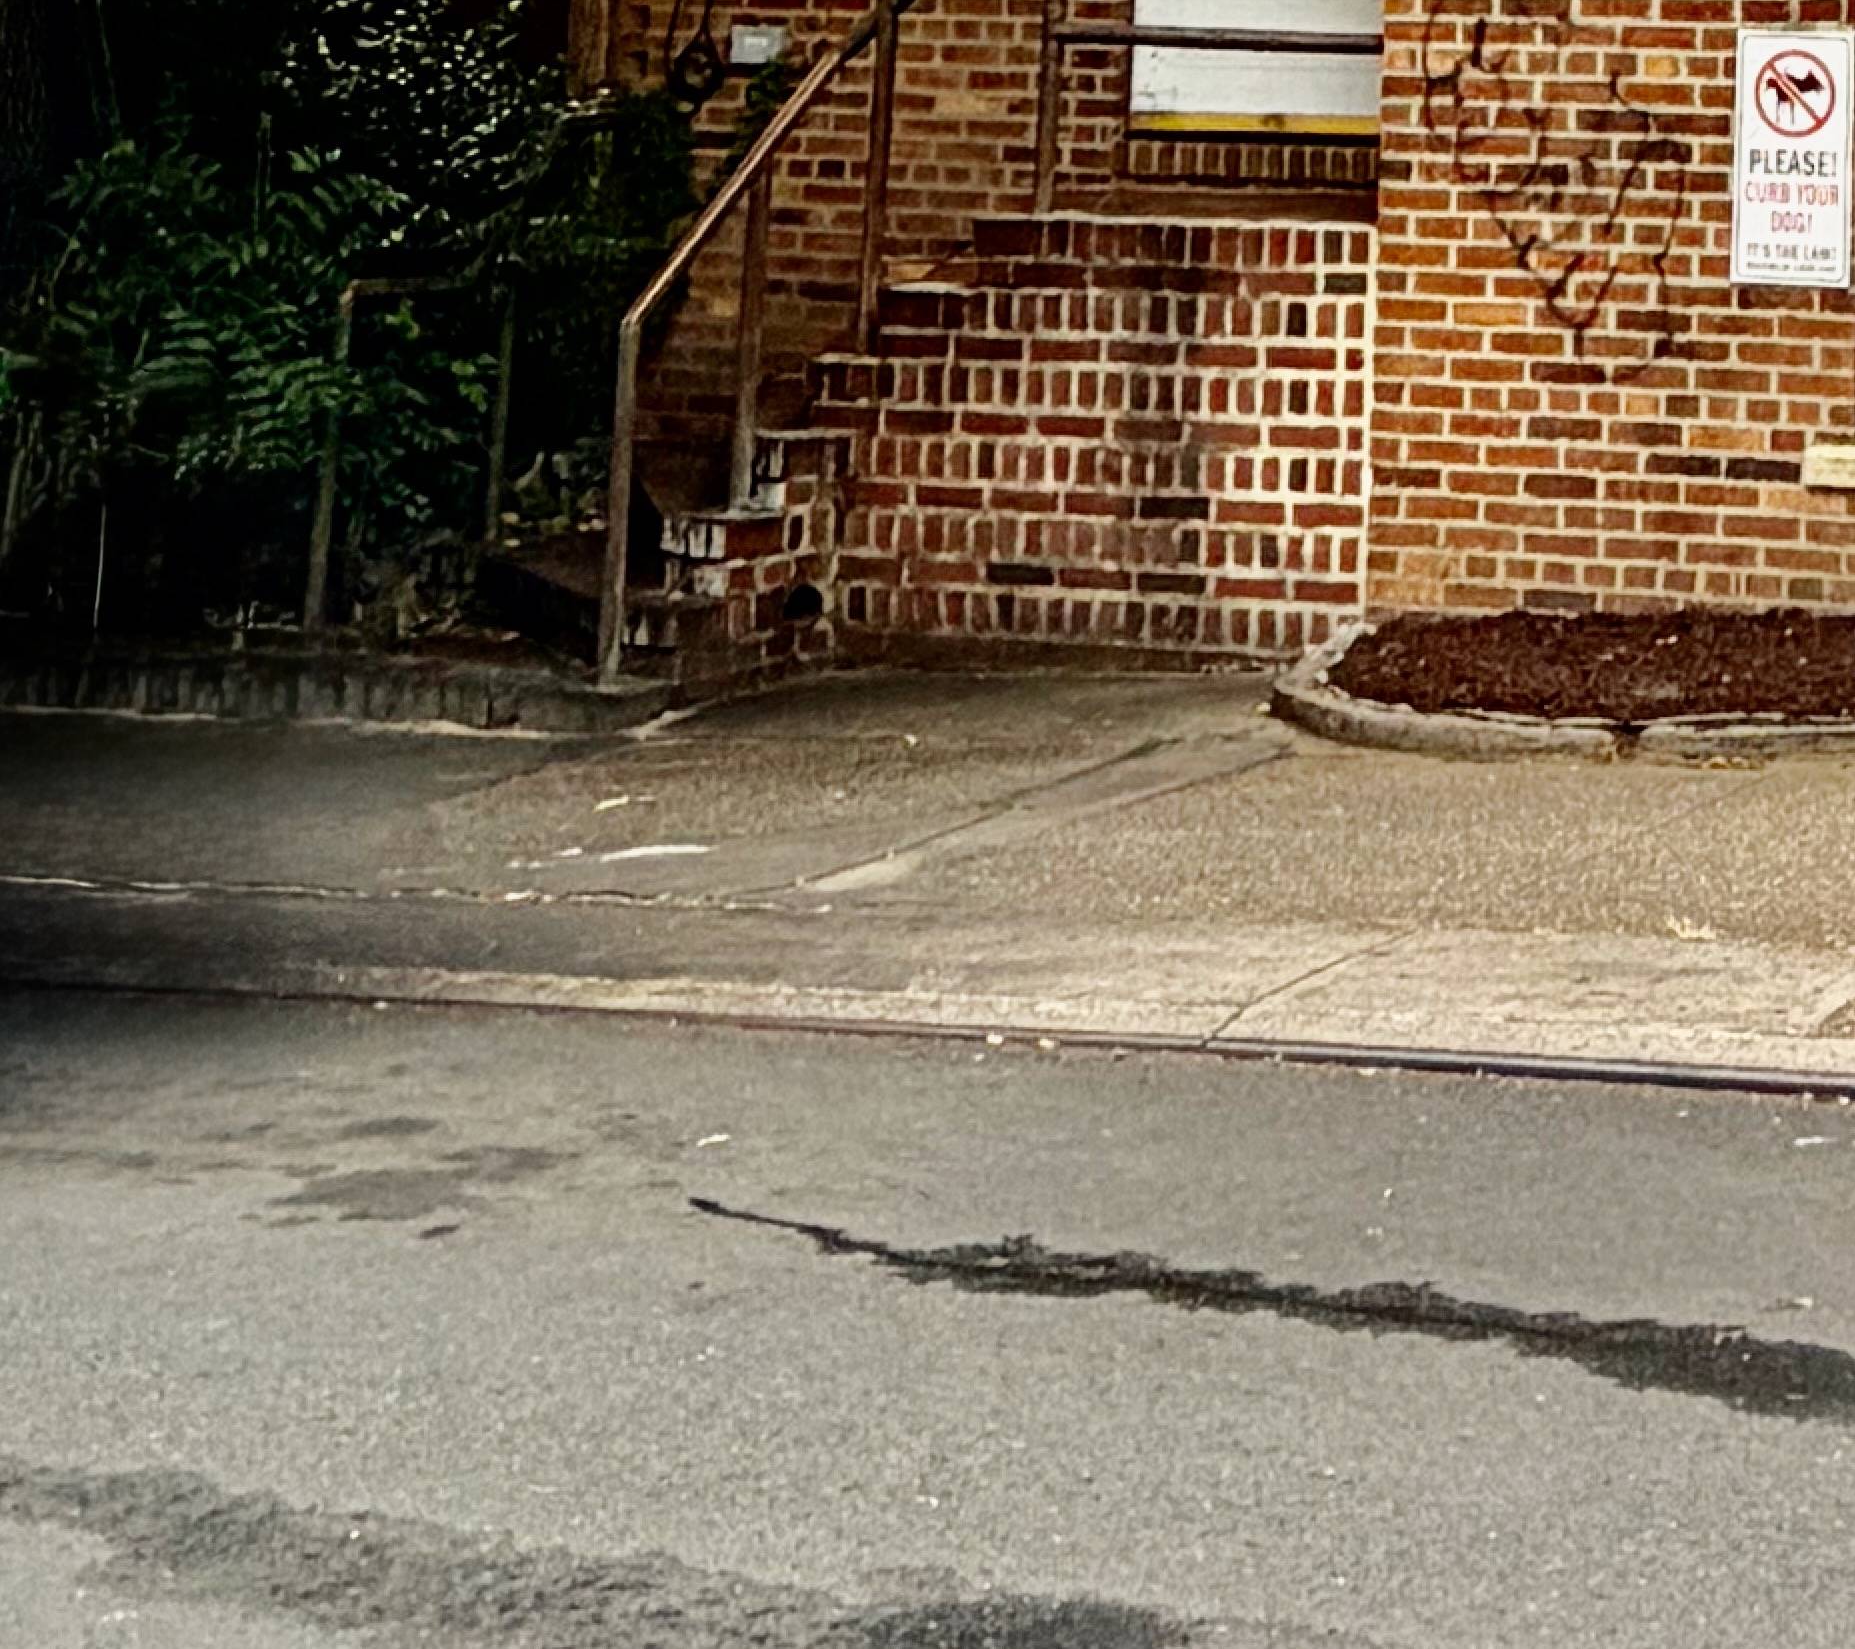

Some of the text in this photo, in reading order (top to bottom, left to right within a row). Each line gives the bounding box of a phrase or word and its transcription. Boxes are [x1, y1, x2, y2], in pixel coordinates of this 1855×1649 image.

[1749, 148, 1837, 177] PLEASE!
[1745, 181, 1839, 206] CURB YOUR
[1771, 210, 1813, 233] DOG!
